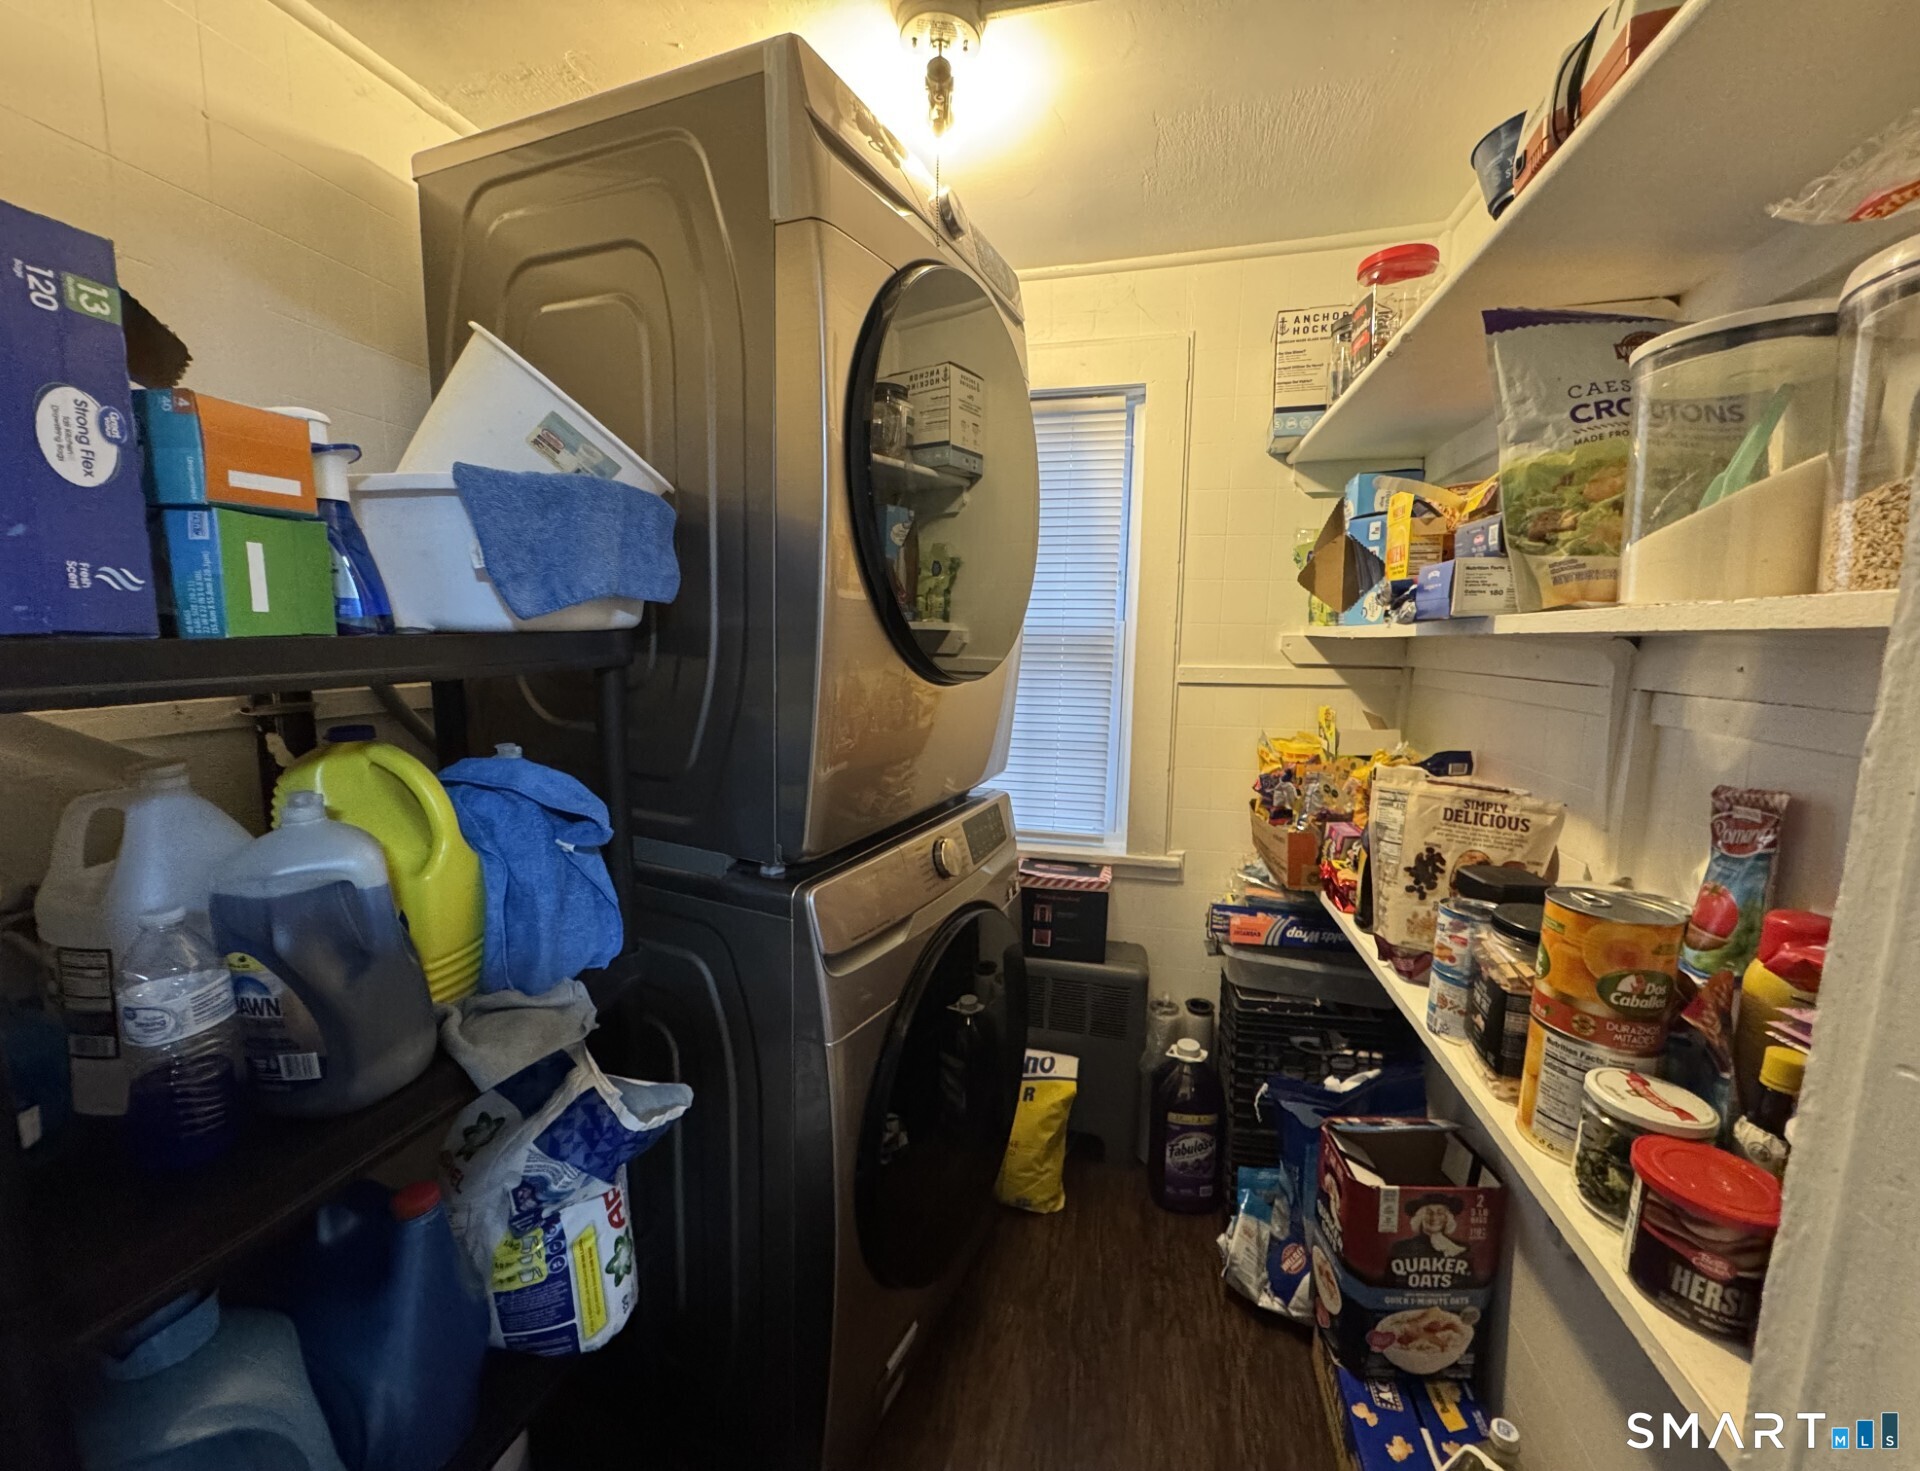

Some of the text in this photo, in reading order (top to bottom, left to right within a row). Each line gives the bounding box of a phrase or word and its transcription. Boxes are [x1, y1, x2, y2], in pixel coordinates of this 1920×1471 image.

[25, 264, 58, 311] 120
[77, 283, 111, 316] 13
[1293, 324, 1328, 335] HOCK
[1568, 379, 1631, 399] CAES
[109, 411, 121, 439] Great
[73, 399, 96, 478] Strong Flex
[1574, 429, 1630, 446] MADE FRO
[66, 560, 81, 589] Scent
[79, 562, 92, 589] Fresh
[1464, 799, 1508, 814] SIMPLY
[1443, 807, 1531, 832] DELICIOUS
[1286, 926, 1320, 943] Wrap
[236, 996, 281, 1017] AWN
[1546, 1036, 1604, 1064] Nutrition Facts
[1390, 1257, 1469, 1276] QUAKER
[1407, 1273, 1452, 1288] OATS
